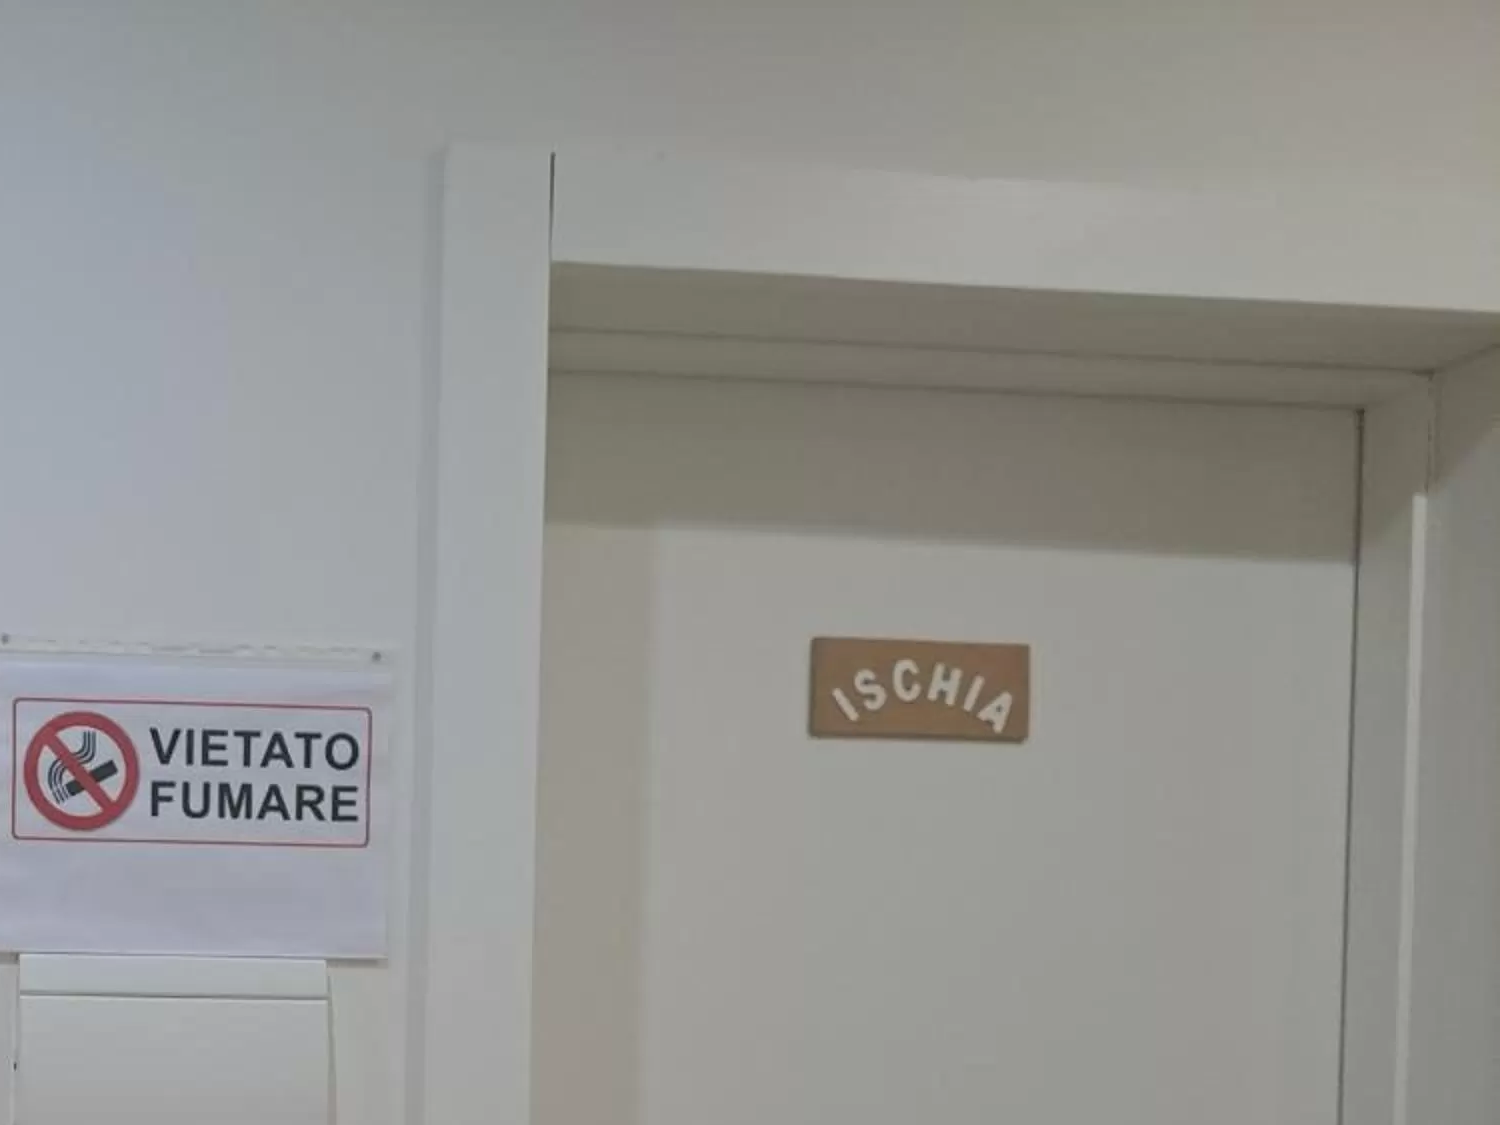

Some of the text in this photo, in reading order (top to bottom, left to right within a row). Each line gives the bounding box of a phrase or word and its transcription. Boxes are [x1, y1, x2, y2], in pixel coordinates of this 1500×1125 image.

[832, 658, 1013, 733] ISCHIA
[149, 727, 359, 771] VIETATO
[150, 781, 359, 822] FUMARE
